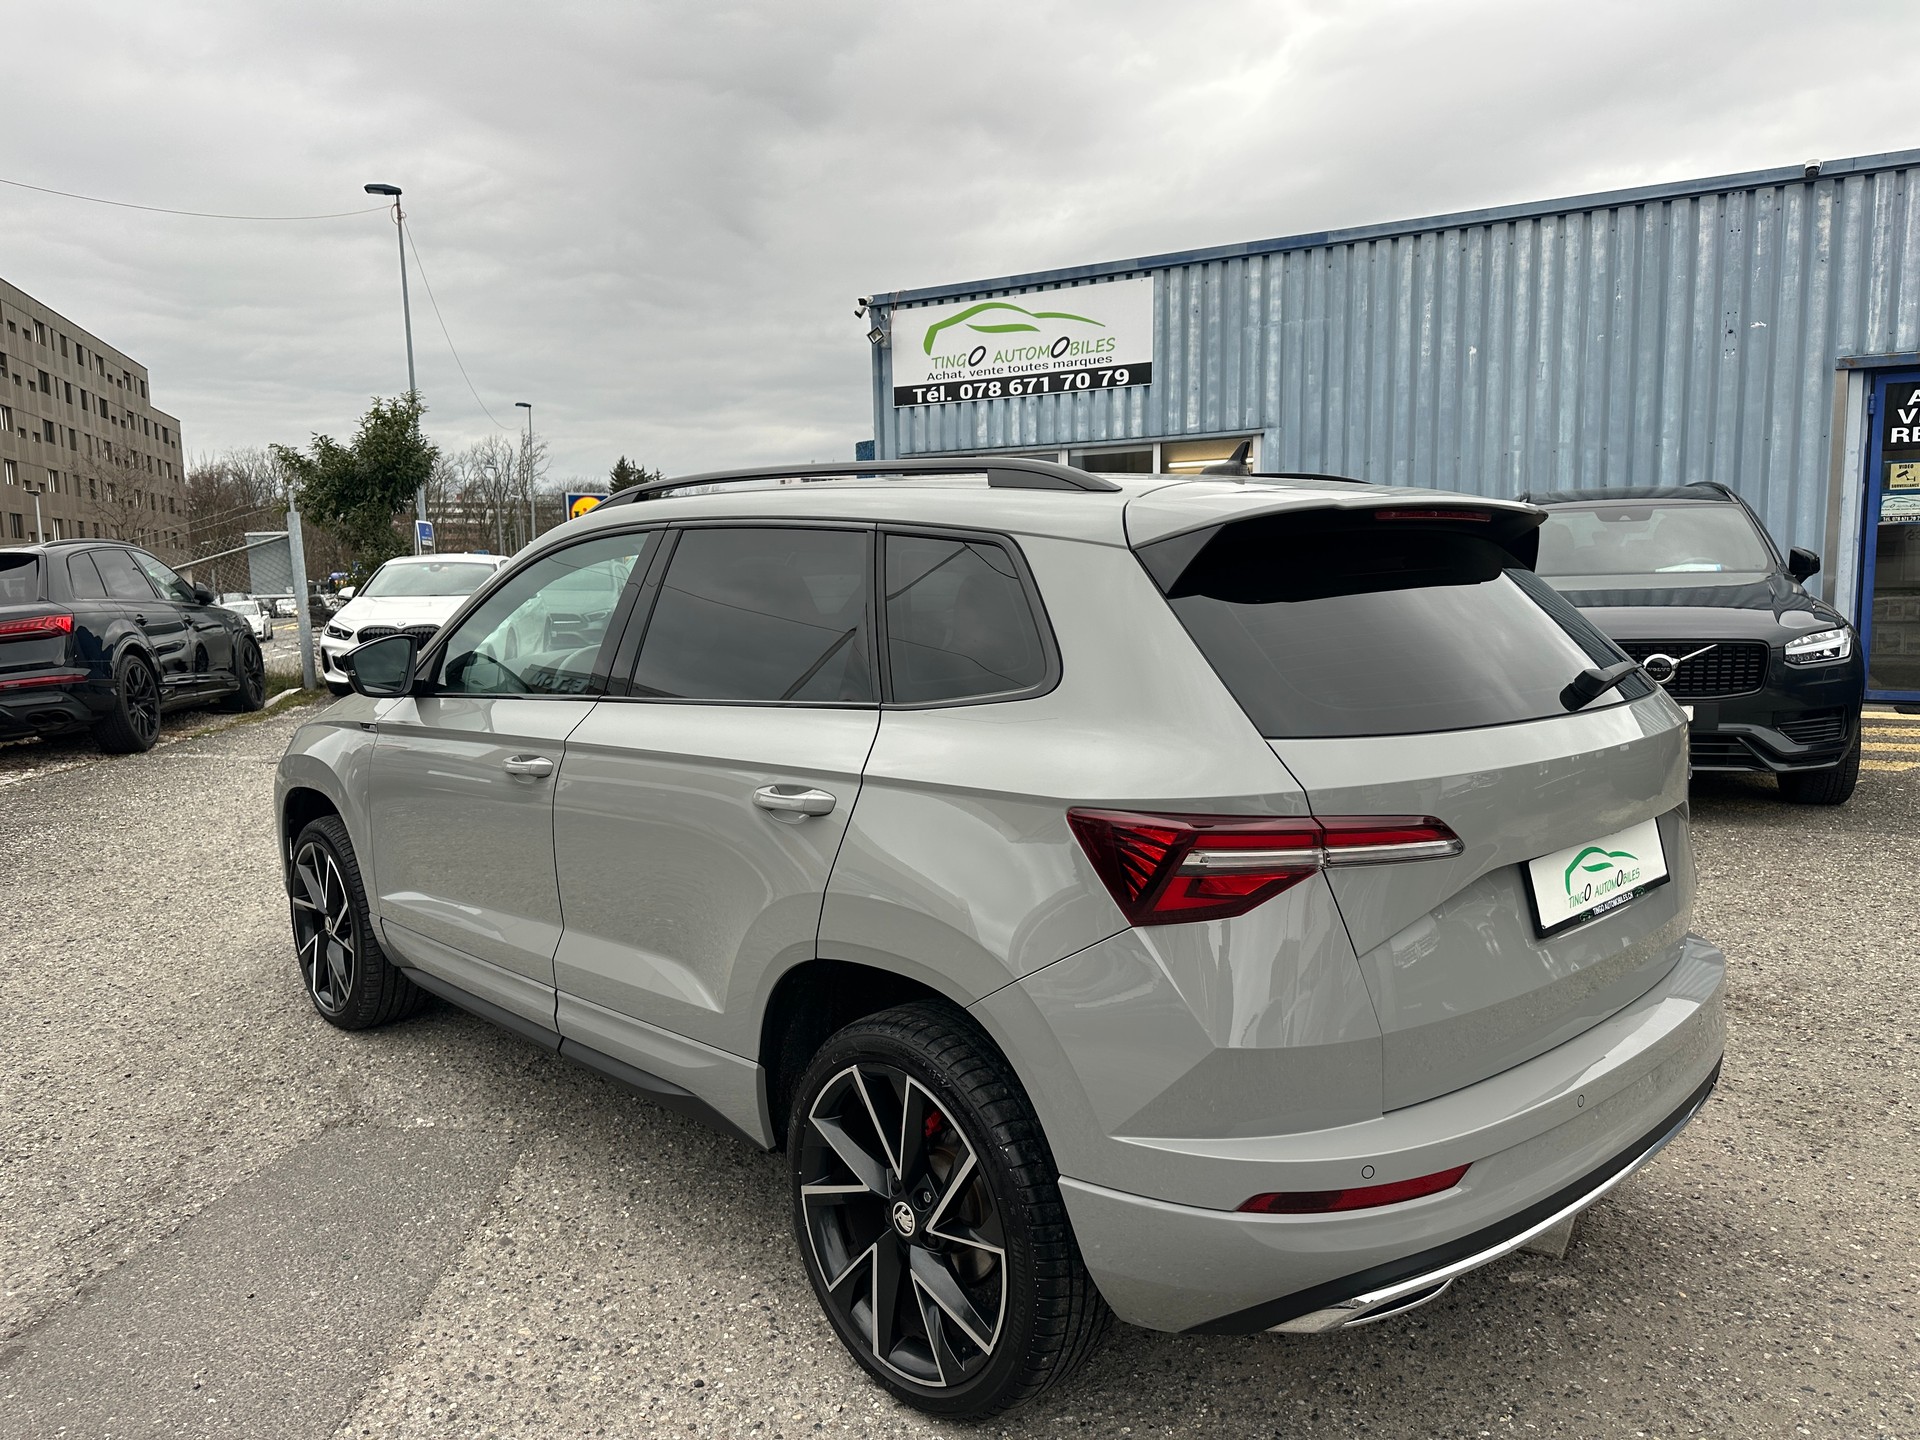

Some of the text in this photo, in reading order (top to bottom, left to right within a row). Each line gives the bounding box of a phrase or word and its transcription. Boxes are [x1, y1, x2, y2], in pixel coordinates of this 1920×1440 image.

[926, 355, 1113, 382] Achat, vente toutes marques
[931, 336, 1116, 370] TINGO AUTOMOBILES
[912, 368, 1130, 404] Tél. 078 671 70 79
[1897, 408, 1920, 424] V
[1568, 868, 1640, 908] TINGO AUTOMOBILES
